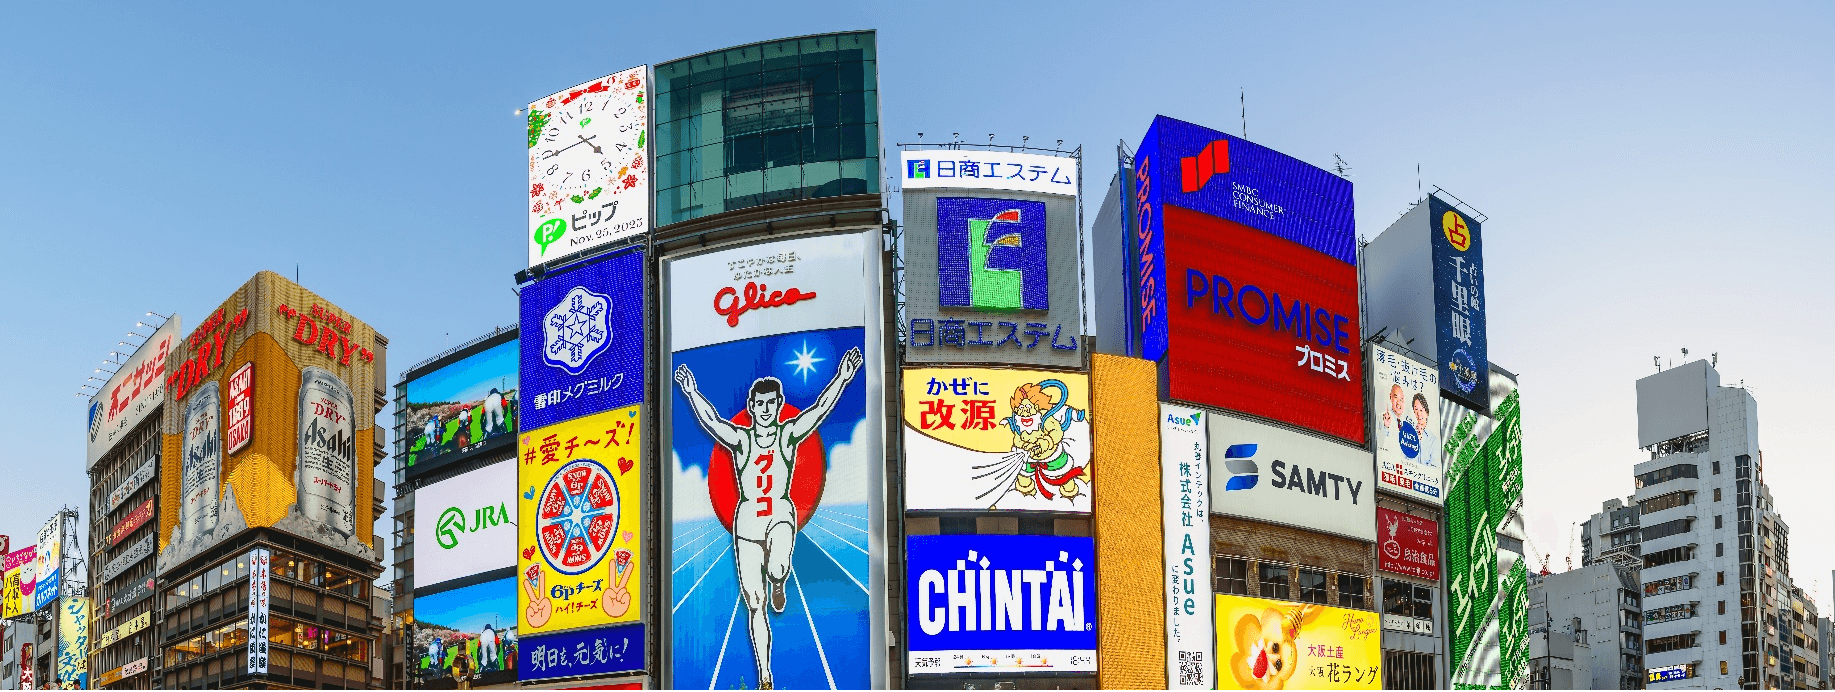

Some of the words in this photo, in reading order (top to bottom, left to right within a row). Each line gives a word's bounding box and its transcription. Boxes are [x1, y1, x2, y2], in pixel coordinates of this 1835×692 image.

[938, 158, 1073, 185] 日商エステム
[1232, 181, 1259, 197] SMBC
[571, 200, 619, 232] ピップ
[1232, 190, 1285, 216] CONSUMER
[1233, 199, 1275, 220] FINANCE
[1136, 155, 1156, 334] PROMISE
[1447, 213, 1466, 249] 占
[311, 303, 353, 335] SUPER
[713, 281, 817, 327] Glico
[1186, 267, 1351, 355] PROMISE
[1449, 256, 1473, 348] 千里眼
[189, 308, 225, 351] SUPER
[911, 317, 1079, 351] 日商エステム
[1296, 345, 1351, 382] プロミス
[534, 372, 624, 411] 雪印メグミルク
[926, 377, 989, 396] かぜに
[919, 399, 997, 431] 改源
[1167, 413, 1191, 426] Asue
[228, 420, 250, 452] OSAKA
[304, 416, 351, 463] Asahi
[754, 449, 775, 518] グリコ
[1179, 462, 1194, 527] 株式会社
[1271, 459, 1363, 505] SAMTY
[470, 502, 511, 534] JRA
[1180, 533, 1196, 616] Asue
[918, 550, 1085, 636] CHINTAI
[1307, 643, 1345, 660] 大阪土産
[1326, 662, 1379, 686] 花ラング
